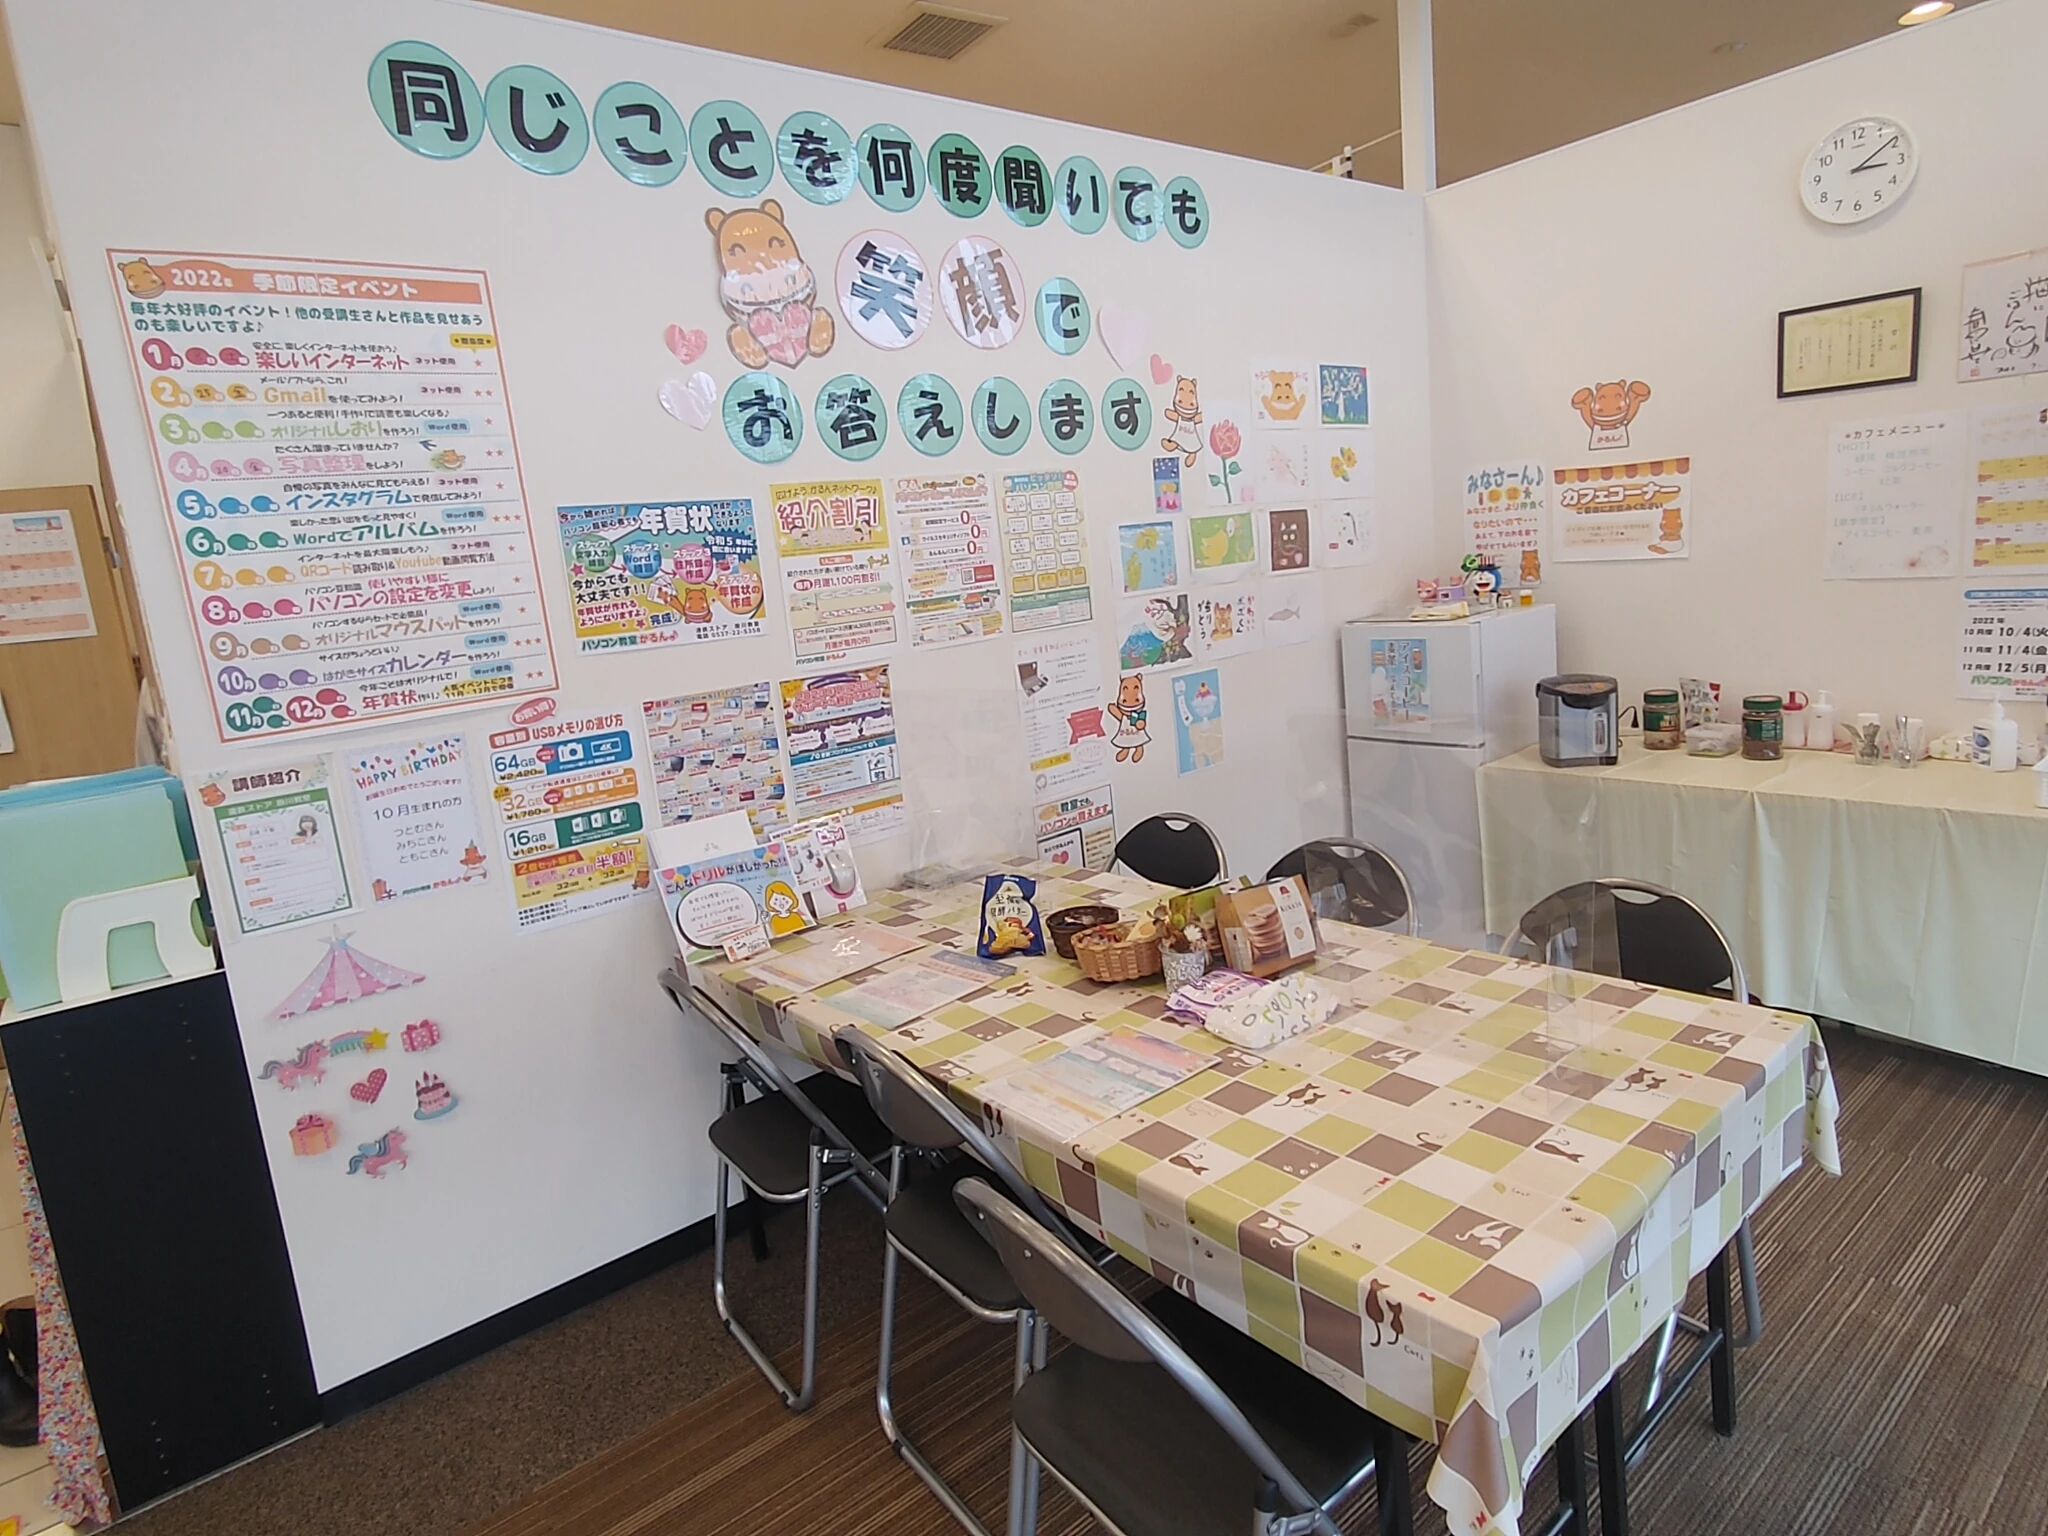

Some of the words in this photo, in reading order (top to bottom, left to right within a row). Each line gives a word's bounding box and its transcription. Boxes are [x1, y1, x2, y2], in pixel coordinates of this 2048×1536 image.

[1852, 127, 1865, 140] 12
[387, 59, 1201, 235] 同じことを何度聞いても
[1833, 138, 1845, 150] 11
[1819, 155, 1833, 168] 10
[1897, 153, 1905, 165] 3
[1813, 175, 1822, 186] 9
[1888, 174, 1897, 185] 4
[1820, 192, 1828, 203] 8
[1873, 190, 1882, 202] 5
[1835, 199, 1843, 212] 7
[1853, 200, 1862, 211] 6
[849, 239, 1080, 340] 笑顔で
[256, 351, 410, 370] 楽しいインターネット
[737, 386, 1142, 450] お答えします
[1561, 481, 1681, 507] カフェコーナー
[639, 504, 713, 535] 年賀状
[777, 495, 879, 532] 紹介割引
[572, 574, 628, 591] 今からでも
[532, 714, 624, 740] USBメモリの選び方
[356, 767, 397, 790] HAPPY
[400, 750, 463, 777] BIRTHDAY
[495, 754, 536, 772] 64GB
[509, 830, 547, 848] 16GB
